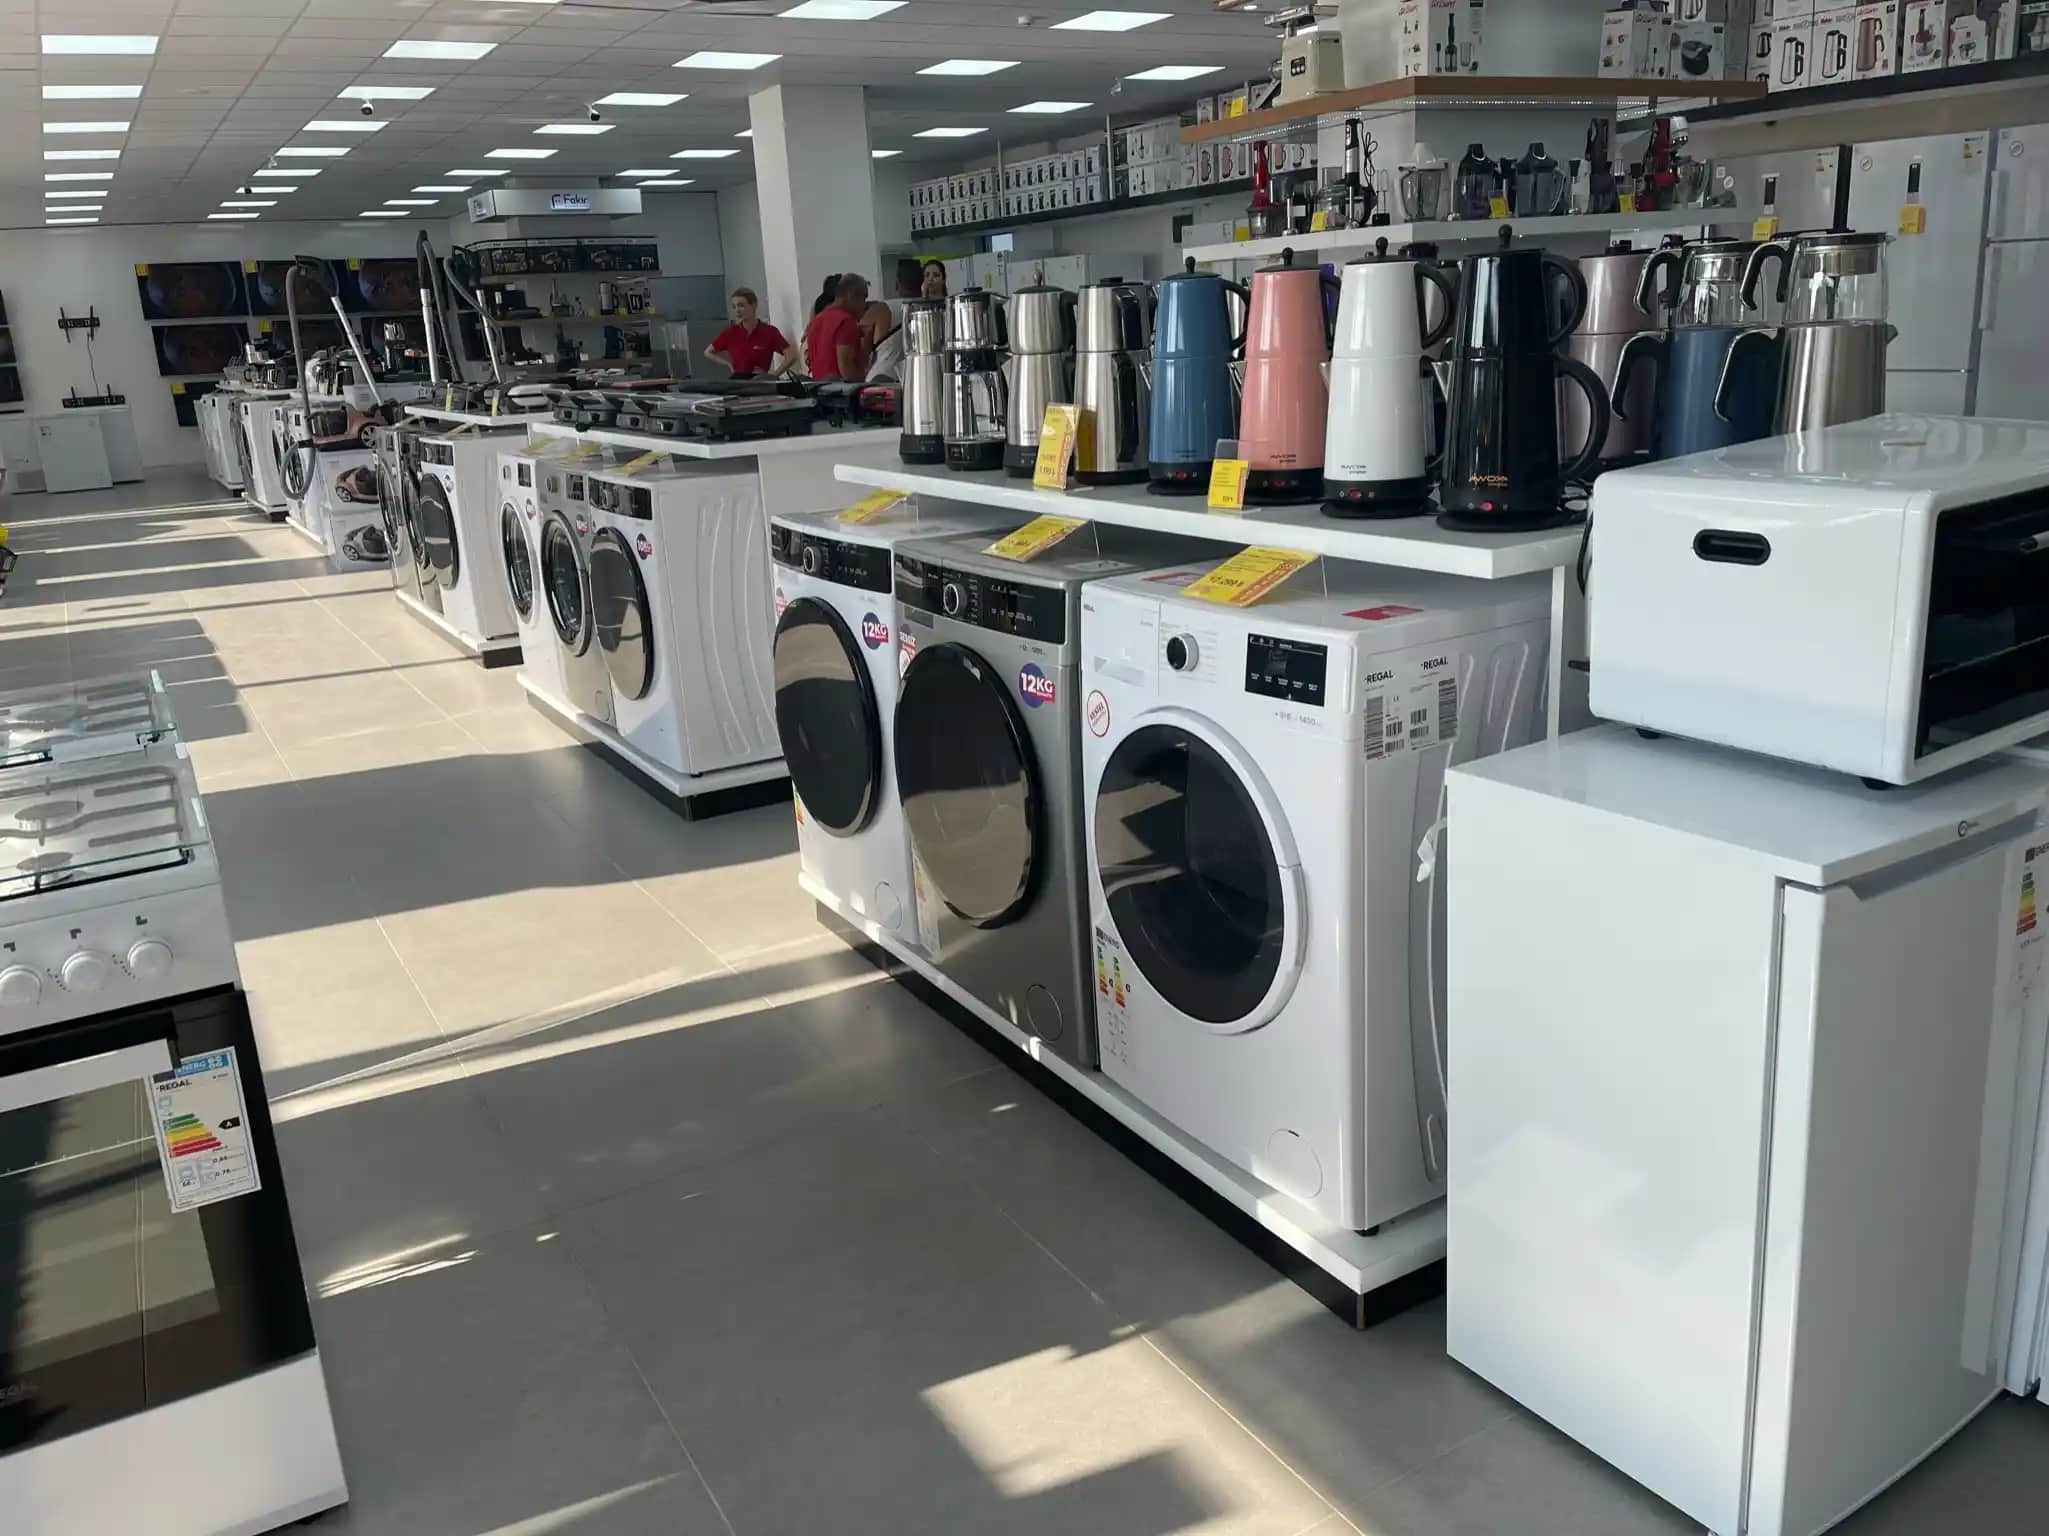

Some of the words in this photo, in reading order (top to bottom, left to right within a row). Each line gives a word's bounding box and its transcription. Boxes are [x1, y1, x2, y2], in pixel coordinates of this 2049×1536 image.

[563, 193, 588, 205] Fakir
[863, 621, 888, 638] 12KG
[1423, 656, 1449, 670] REGAL
[1021, 672, 1054, 694] 12KG
[1365, 670, 1394, 684] REGAL
[159, 1079, 193, 1093] REGAL
